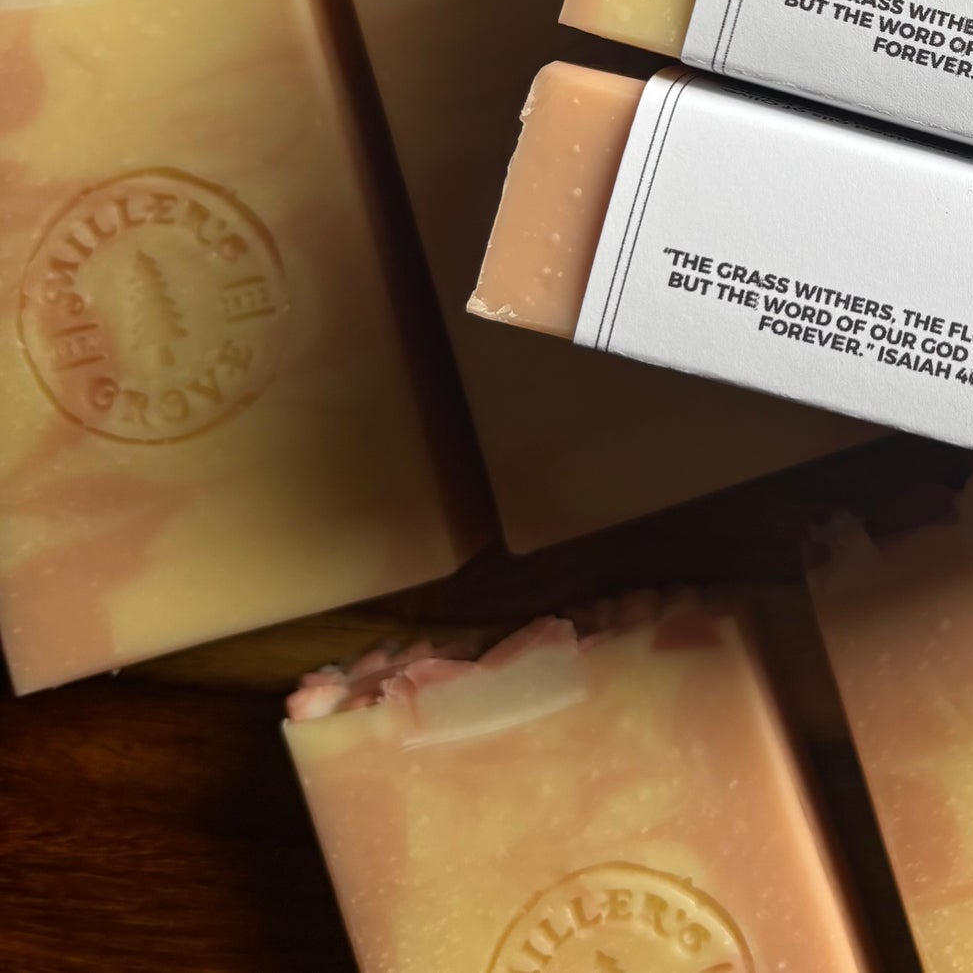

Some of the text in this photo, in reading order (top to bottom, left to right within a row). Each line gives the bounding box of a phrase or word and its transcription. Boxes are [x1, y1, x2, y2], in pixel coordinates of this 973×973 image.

[832, 2, 875, 29] THE
[879, 14, 946, 48] WORD
[667, 270, 714, 296] BUT
[716, 282, 761, 311] THE
[763, 294, 832, 327] WORD
[835, 315, 868, 336] OF
[869, 323, 917, 350] OUR
[920, 337, 969, 363] GOD
[716, 261, 791, 295] GRASS
[794, 280, 897, 325] WITHERS,
[902, 308, 946, 336] THE
[876, 345, 953, 380] ISAIAH
[507, 889, 711, 973] ILLER'S
